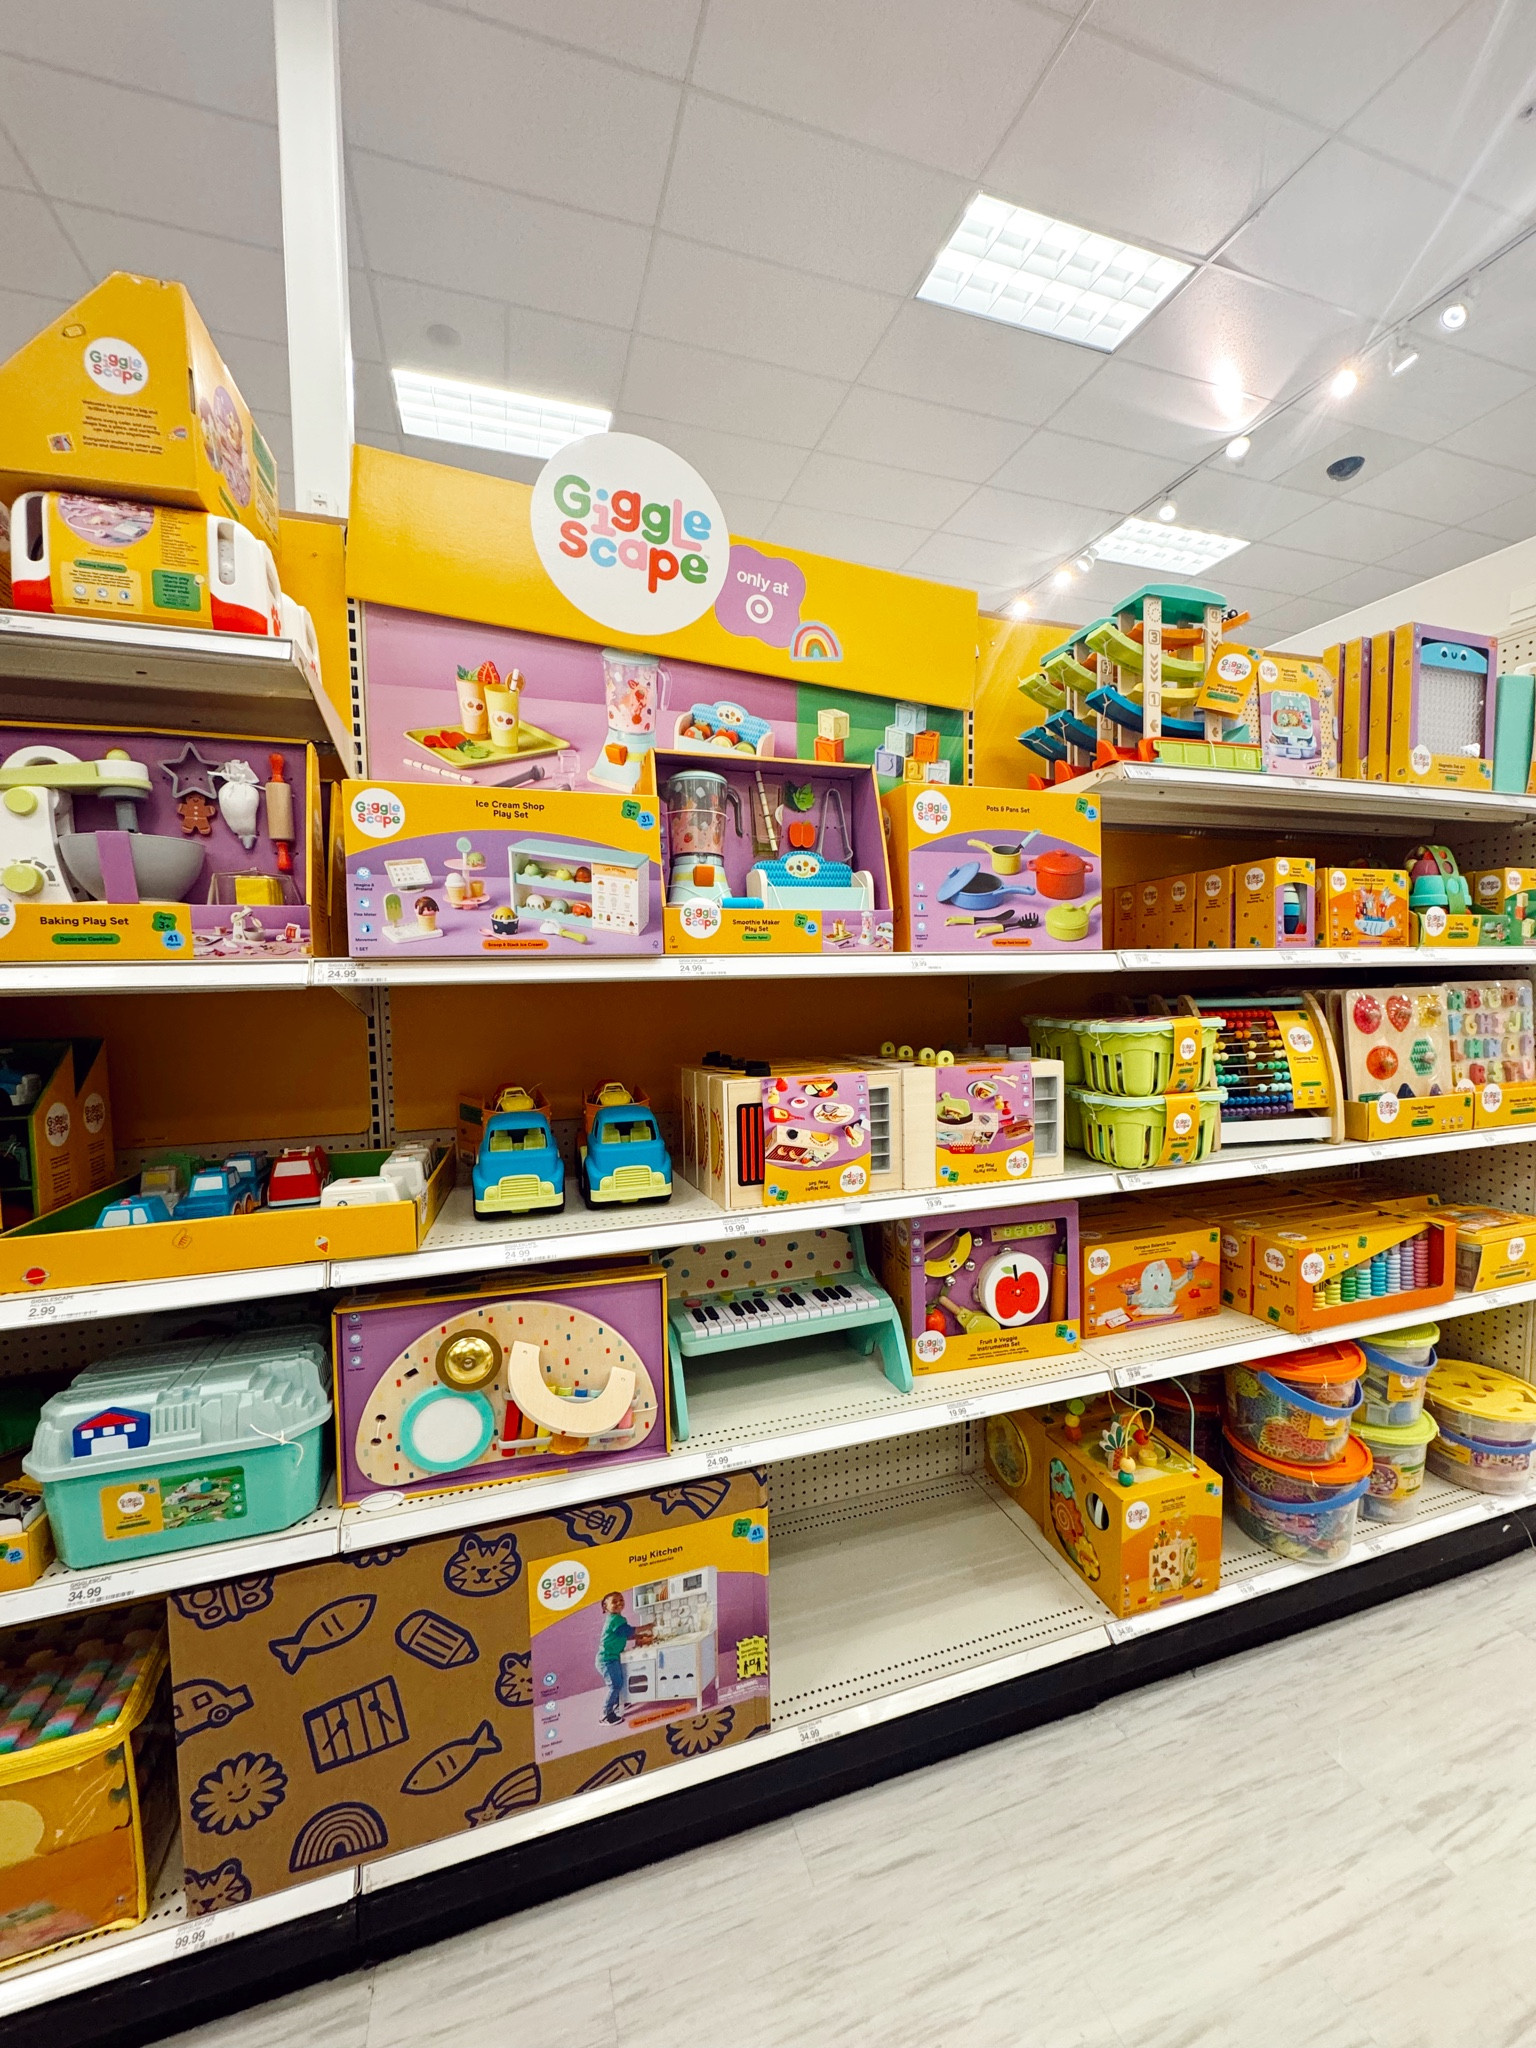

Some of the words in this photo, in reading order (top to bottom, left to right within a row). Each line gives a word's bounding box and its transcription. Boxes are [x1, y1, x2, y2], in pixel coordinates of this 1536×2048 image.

[89, 350, 142, 370] Giggle
[553, 474, 711, 552] Giggle
[736, 569, 772, 593] only
[772, 578, 789, 597] at
[1150, 632, 1158, 643] 3
[355, 800, 400, 816] Giggle
[475, 800, 490, 808] Ice
[492, 801, 520, 810] Cream
[522, 802, 545, 812] Shop
[916, 802, 948, 814] Giggle
[1006, 806, 1019, 814] Pans
[1020, 806, 1030, 814] Set
[493, 810, 508, 820] Play
[510, 810, 528, 819] Set
[626, 809, 636, 817] 3+
[684, 908, 718, 920] Giggle
[40, 916, 79, 927] Baking
[82, 916, 107, 927] Play
[110, 916, 129, 925] Set
[158, 922, 170, 930] 3+
[167, 934, 178, 943] 41
[327, 970, 357, 978] 24.99
[724, 1224, 746, 1233] 19.99
[28, 1306, 56, 1318] 2.99
[999, 1336, 1018, 1344] Veggie
[977, 1344, 1010, 1352] Instruments
[950, 1408, 966, 1416] 19.99
[706, 1456, 728, 1467] 24.99
[752, 1528, 761, 1536] 41
[628, 1554, 647, 1564] Play
[649, 1545, 683, 1558] Kitchen
[541, 1571, 585, 1591] Giggle
[68, 1586, 101, 1602] 34.99
[800, 1729, 820, 1742] 34.99
[174, 1930, 206, 1949] 99.99
